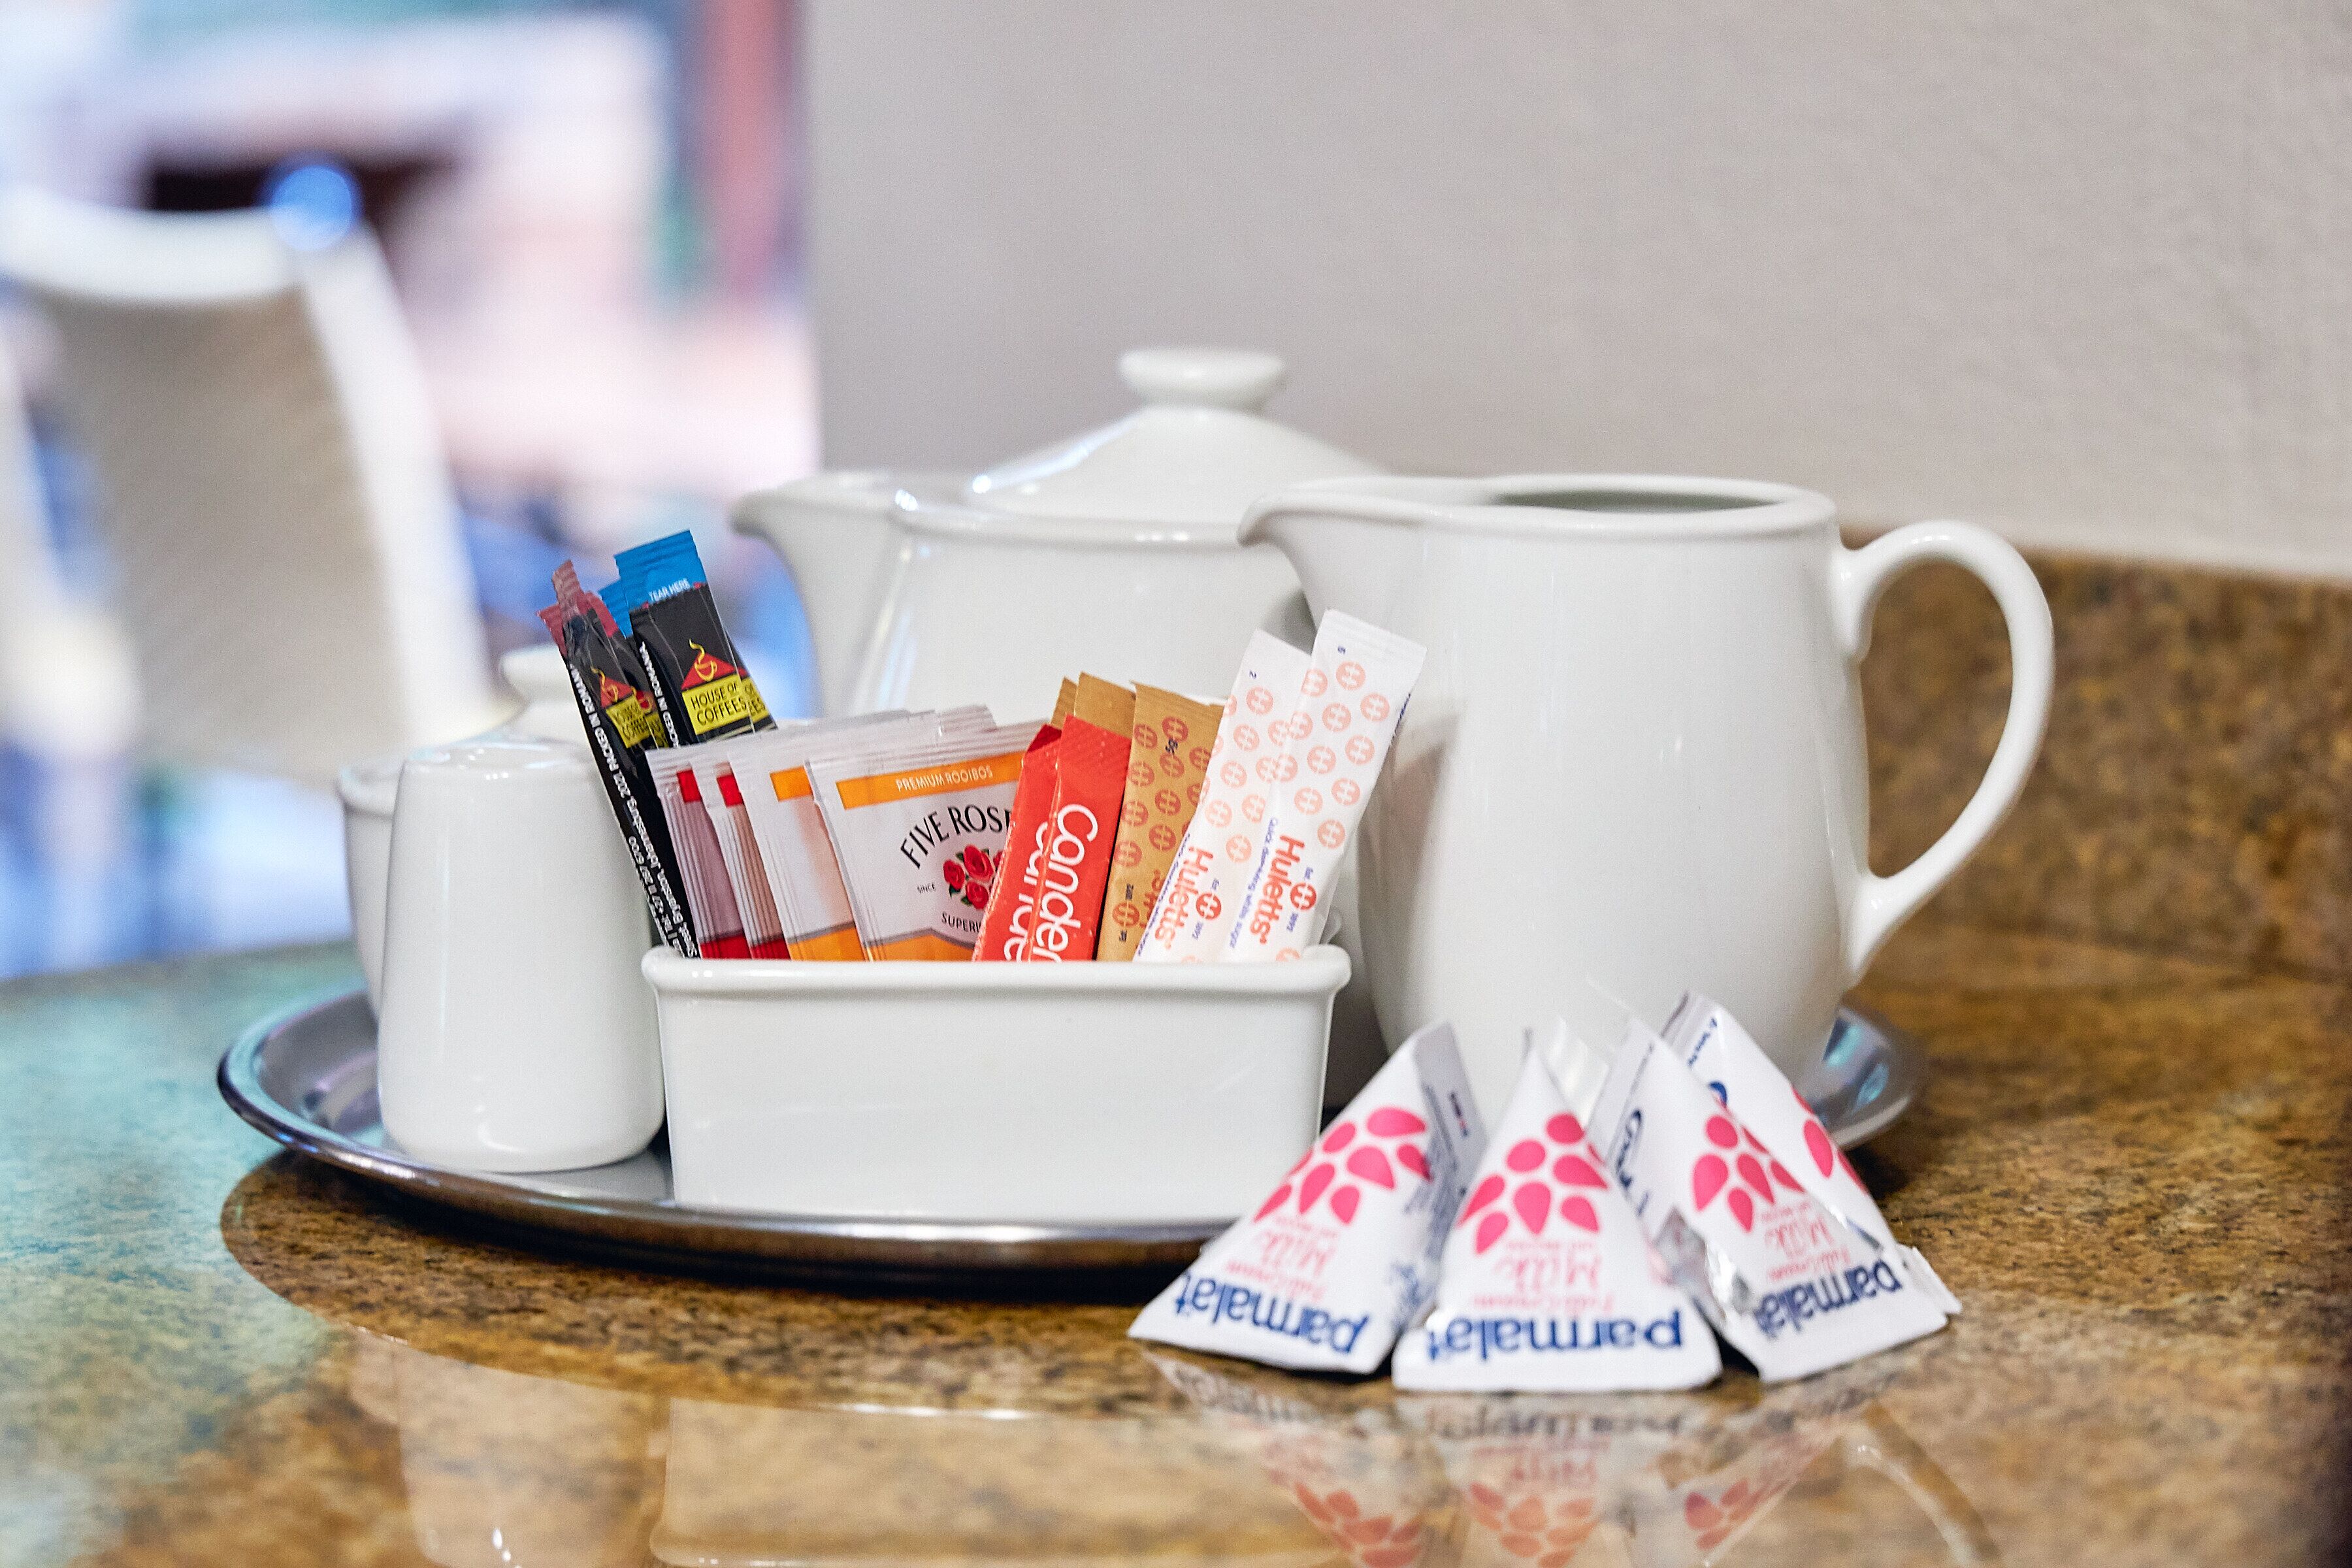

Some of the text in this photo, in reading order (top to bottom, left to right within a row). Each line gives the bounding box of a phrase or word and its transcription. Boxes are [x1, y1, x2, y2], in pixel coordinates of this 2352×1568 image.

[649, 578, 690, 601] TEAR HERE
[657, 697, 668, 711] IN
[691, 685, 727, 710] HOUSE
[697, 696, 747, 726] COFFEES
[589, 713, 600, 727] IN
[662, 711, 679, 747] ACKED
[595, 727, 619, 771] PACKED
[896, 765, 993, 792] PREMIUM ROOIBOS
[900, 804, 1012, 870] FIVE ROS
[917, 882, 936, 894] SINCE
[1032, 803, 1098, 962] Cander
[1154, 846, 1213, 946] Huletts
[1250, 834, 1305, 942] Huletts
[941, 911, 981, 933] SUPERI
[1173, 1269, 1369, 1354] parmalat
[1427, 1308, 1682, 1362] parmalat
